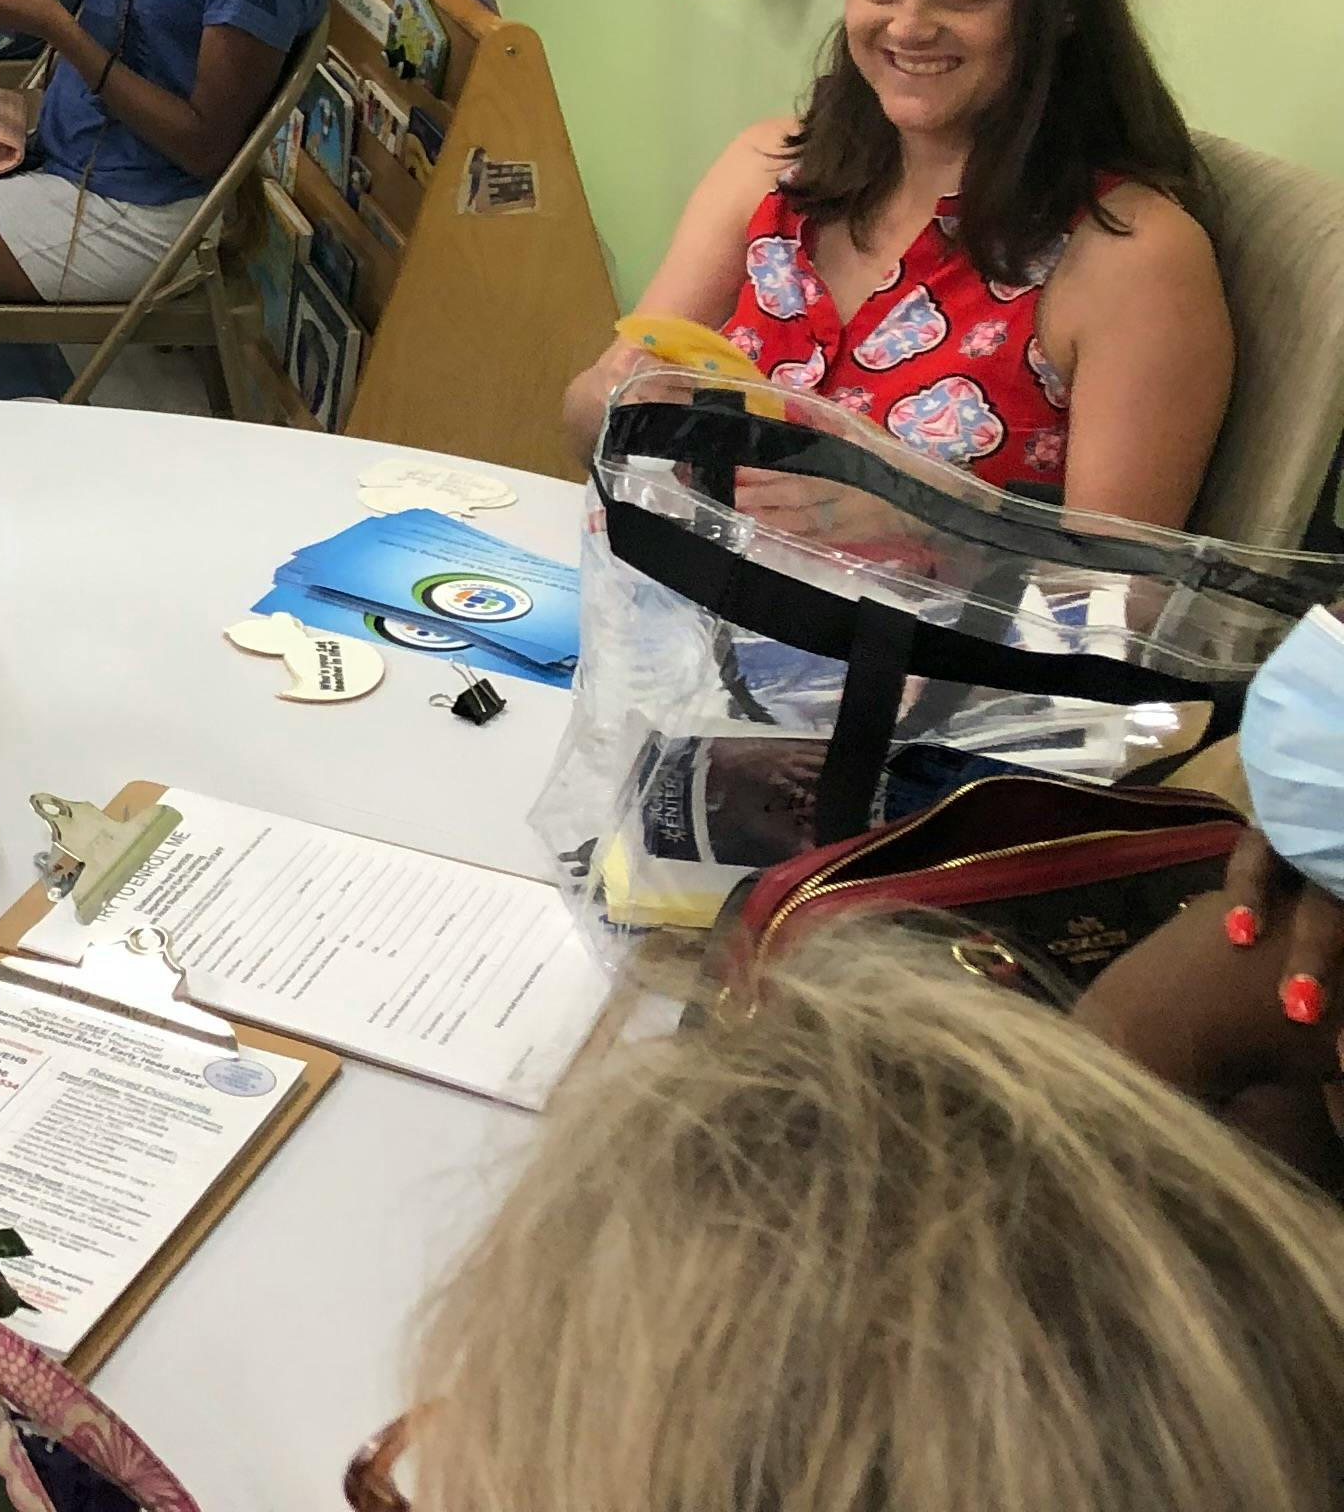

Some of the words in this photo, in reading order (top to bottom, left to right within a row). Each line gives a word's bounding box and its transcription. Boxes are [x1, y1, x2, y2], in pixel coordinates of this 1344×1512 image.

[135, 847, 177, 887] ENROLL
[166, 830, 192, 848] ME
[43, 1025, 74, 1038] Head
[73, 1035, 102, 1047] Start
[108, 1046, 138, 1060] Early
[139, 1056, 171, 1069] Head
[171, 1066, 201, 1080] Start
[86, 1067, 143, 1091] Required
[142, 1085, 212, 1114] Documents
